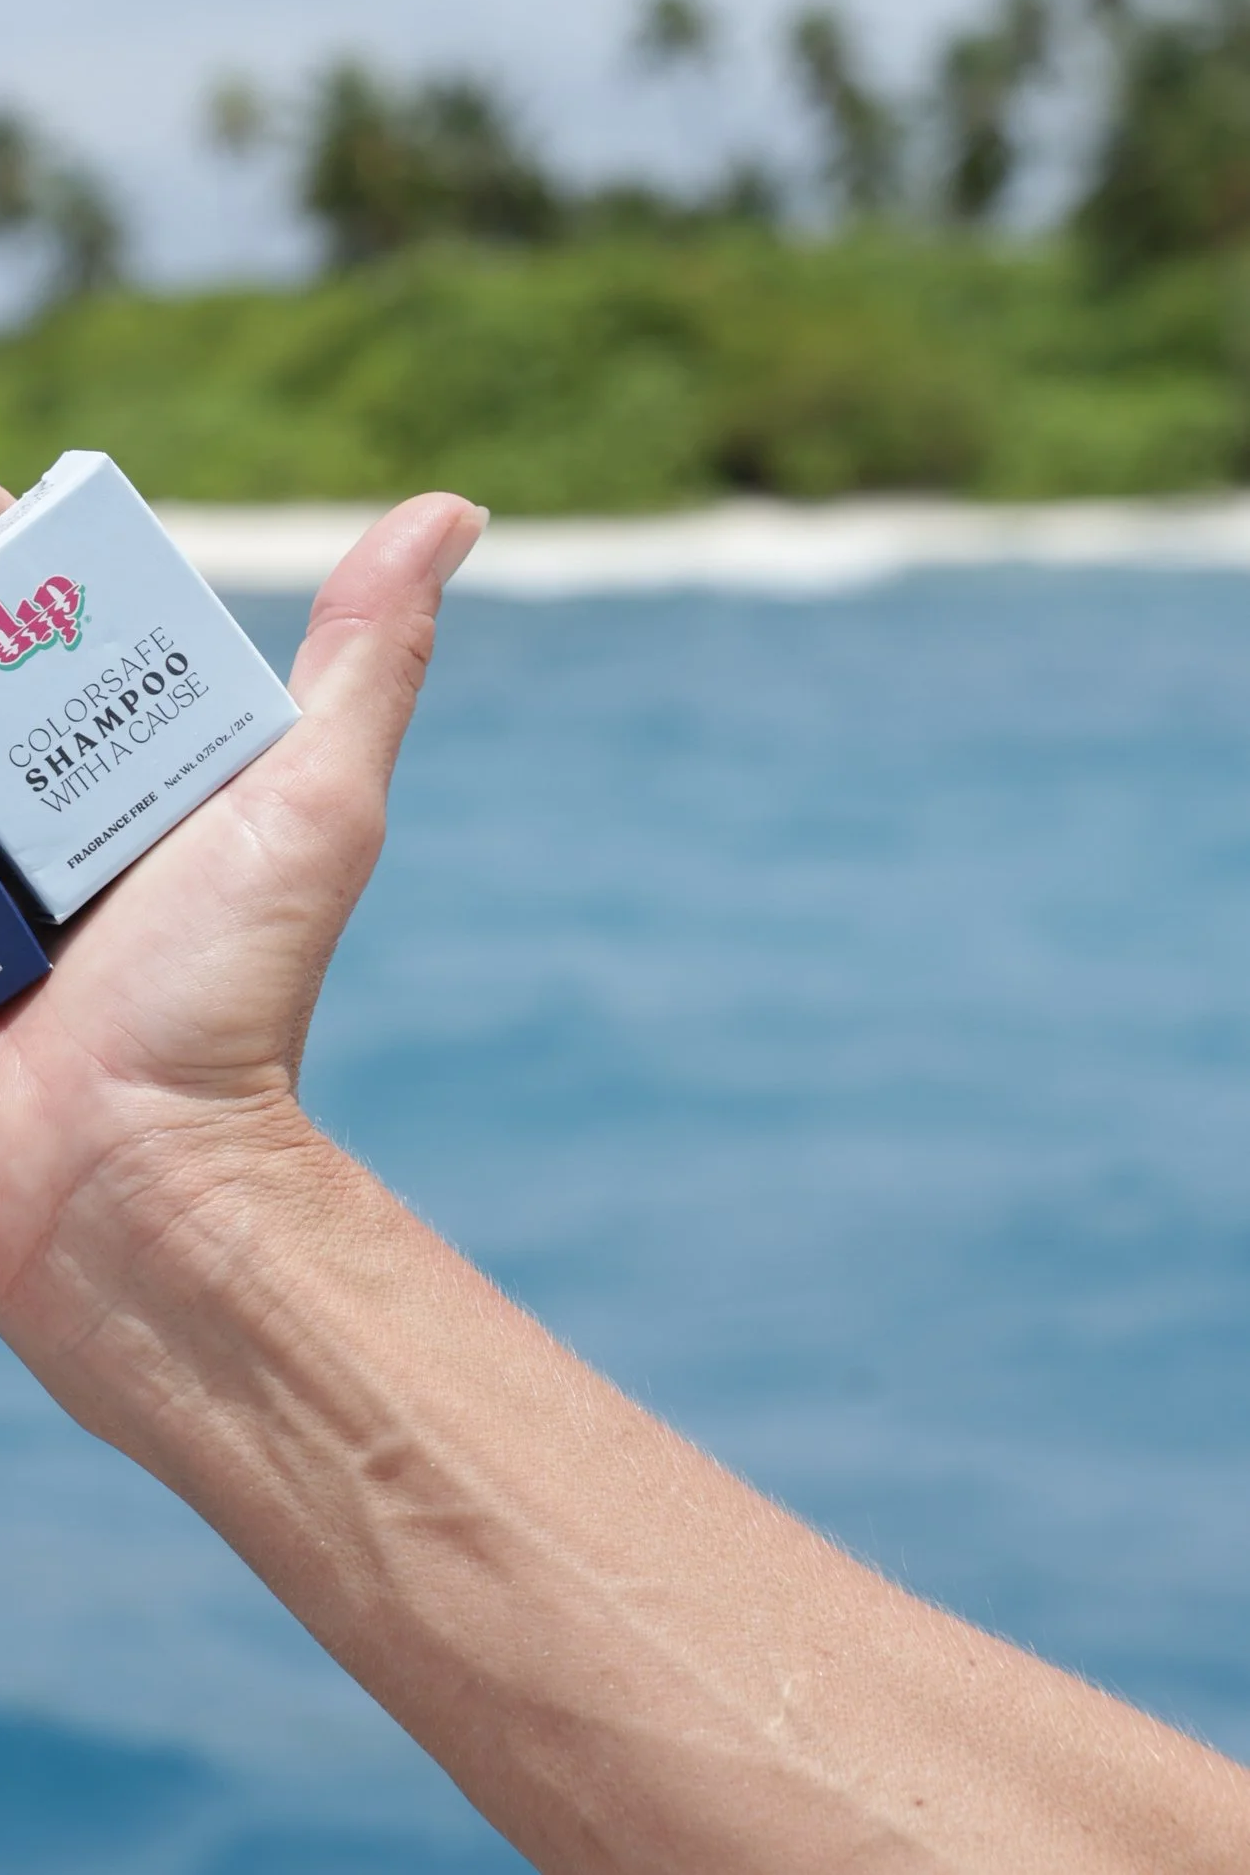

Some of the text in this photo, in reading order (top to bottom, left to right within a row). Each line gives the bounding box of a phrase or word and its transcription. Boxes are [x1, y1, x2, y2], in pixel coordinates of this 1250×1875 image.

[9, 626, 175, 768] COLORSAFE
[25, 652, 188, 792] SHAMPOO
[40, 672, 209, 813] WITH A CAUSE
[164, 773, 183, 789] Net
[179, 762, 198, 776] Wt.
[196, 744, 216, 764] 0.75
[215, 734, 232, 747] Oz.
[234, 719, 247, 732] 21
[244, 712, 254, 722] G
[67, 791, 159, 869] FRAGRANCE FREE
